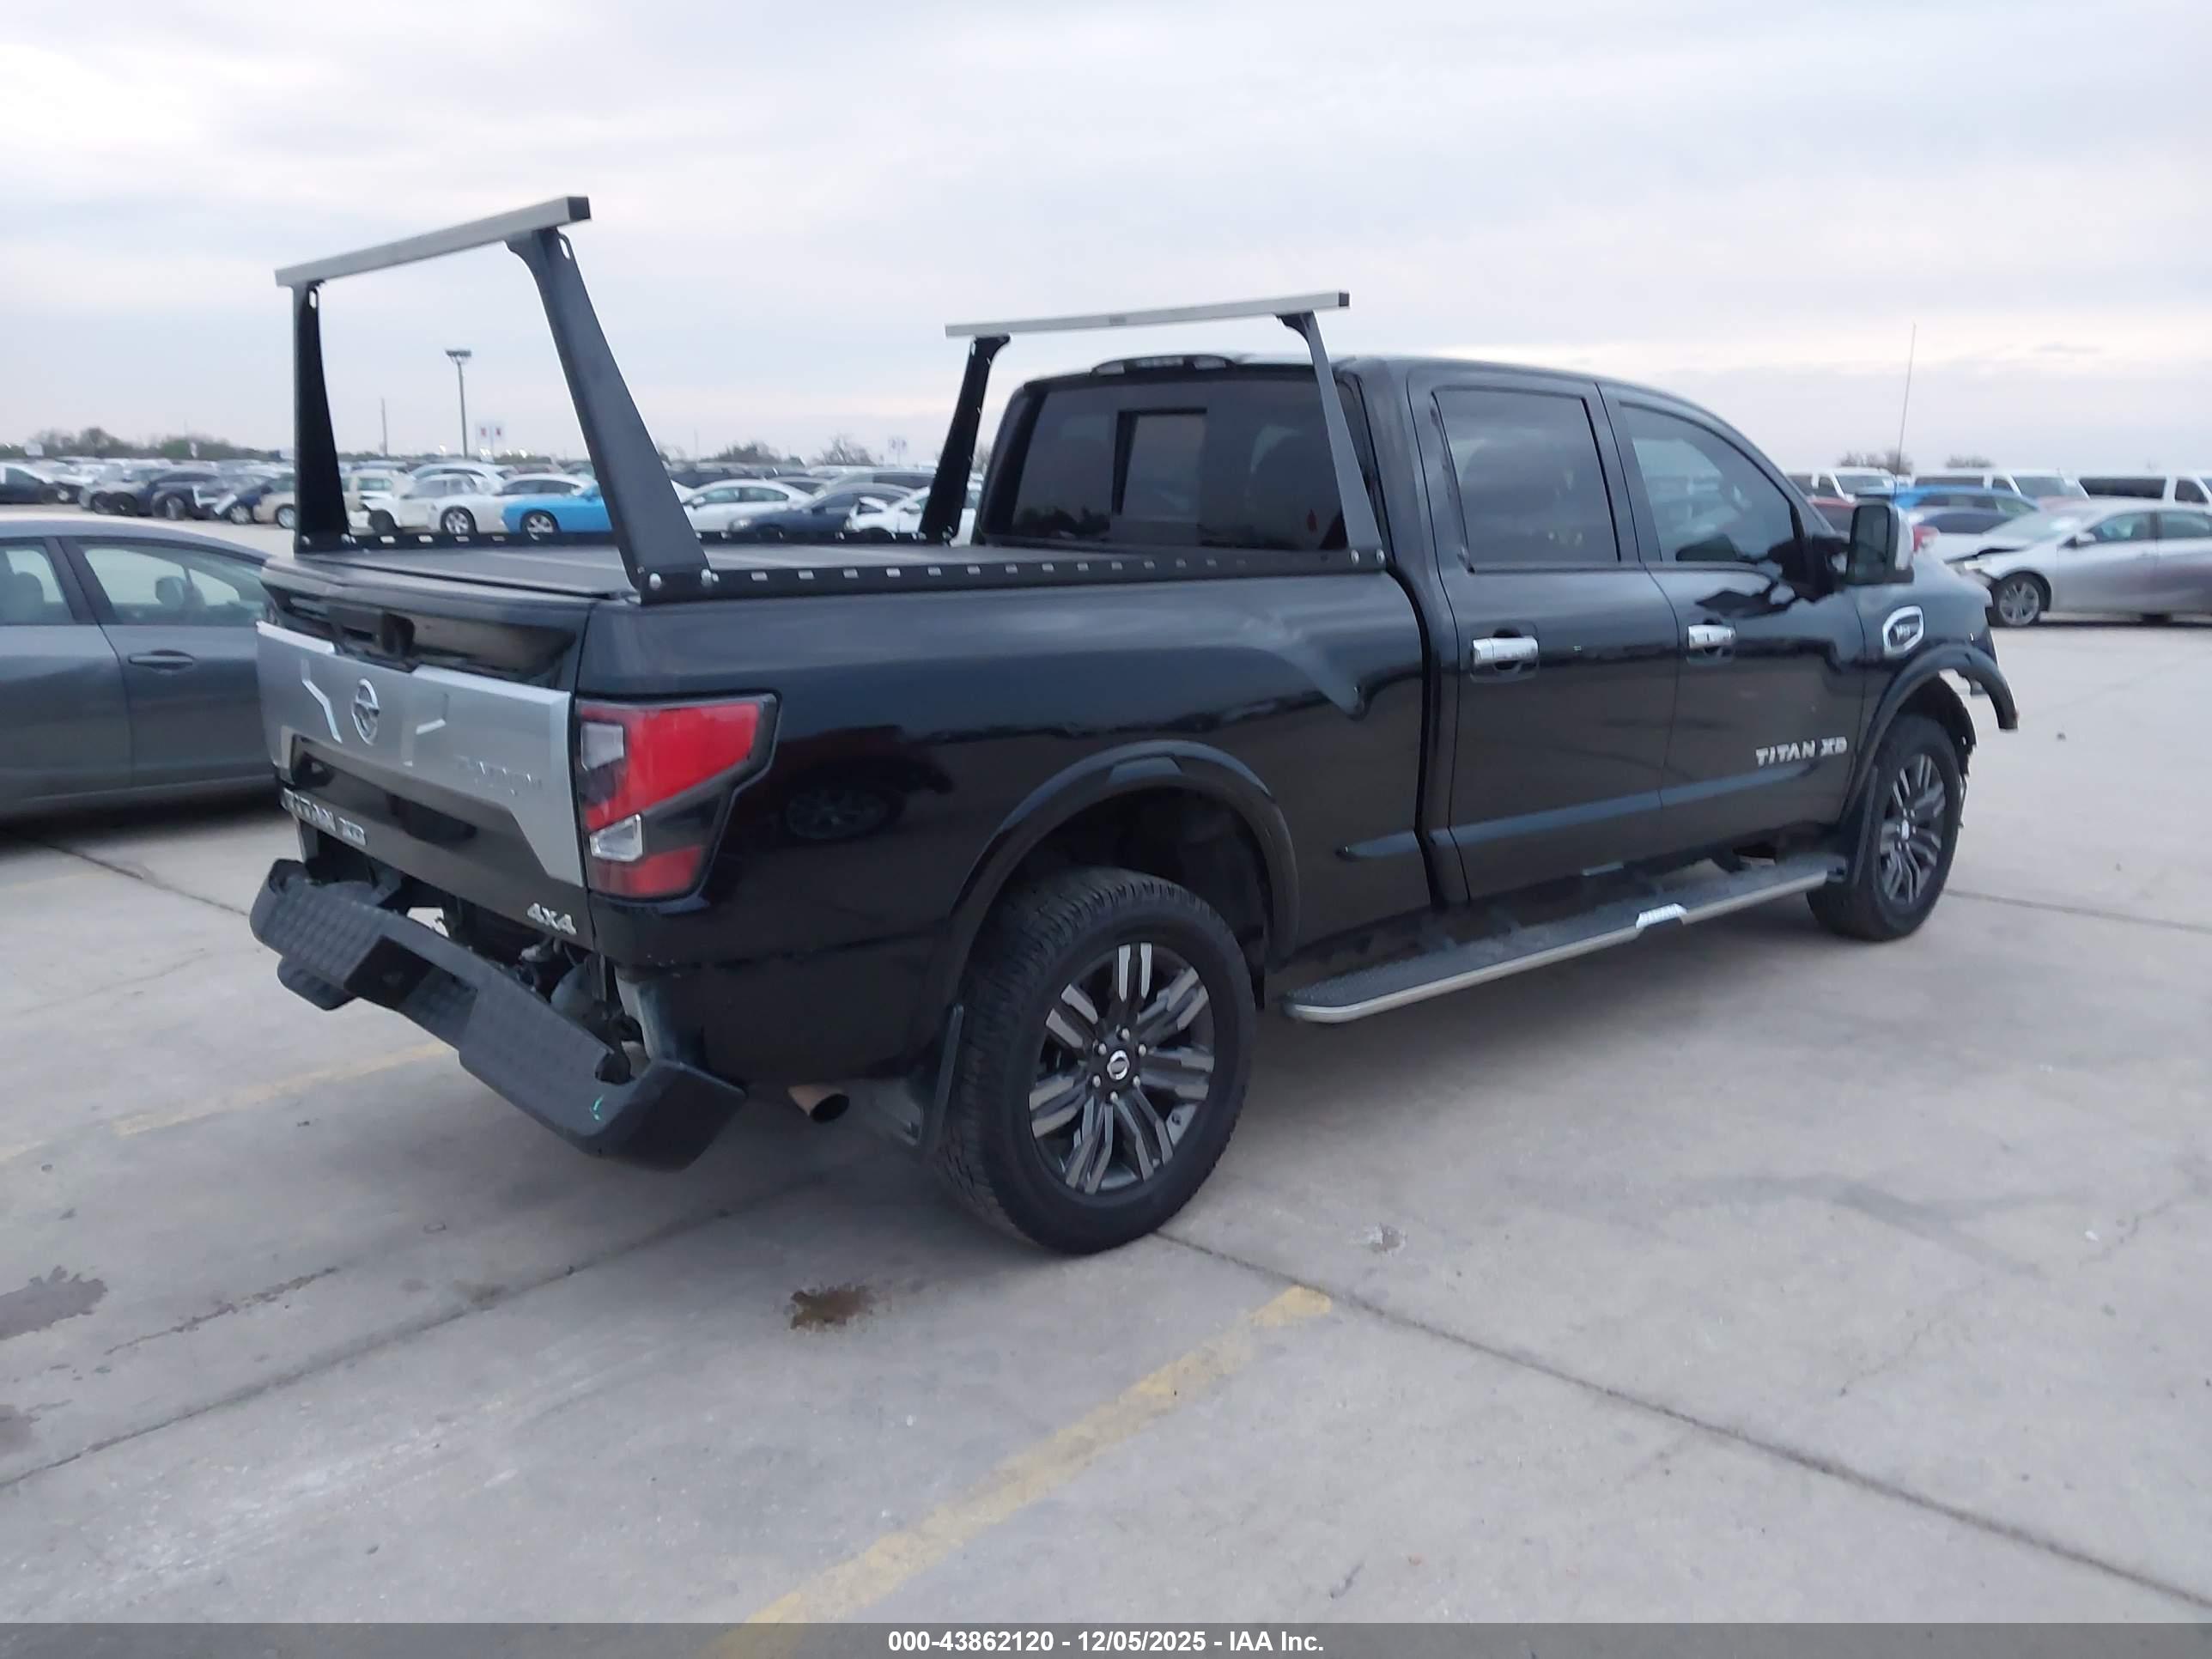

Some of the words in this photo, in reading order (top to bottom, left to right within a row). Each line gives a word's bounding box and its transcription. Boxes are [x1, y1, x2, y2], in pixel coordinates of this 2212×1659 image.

[1756, 740, 1815, 766] TITAN
[1820, 737, 1847, 757] XD
[280, 787, 336, 832] TITAN
